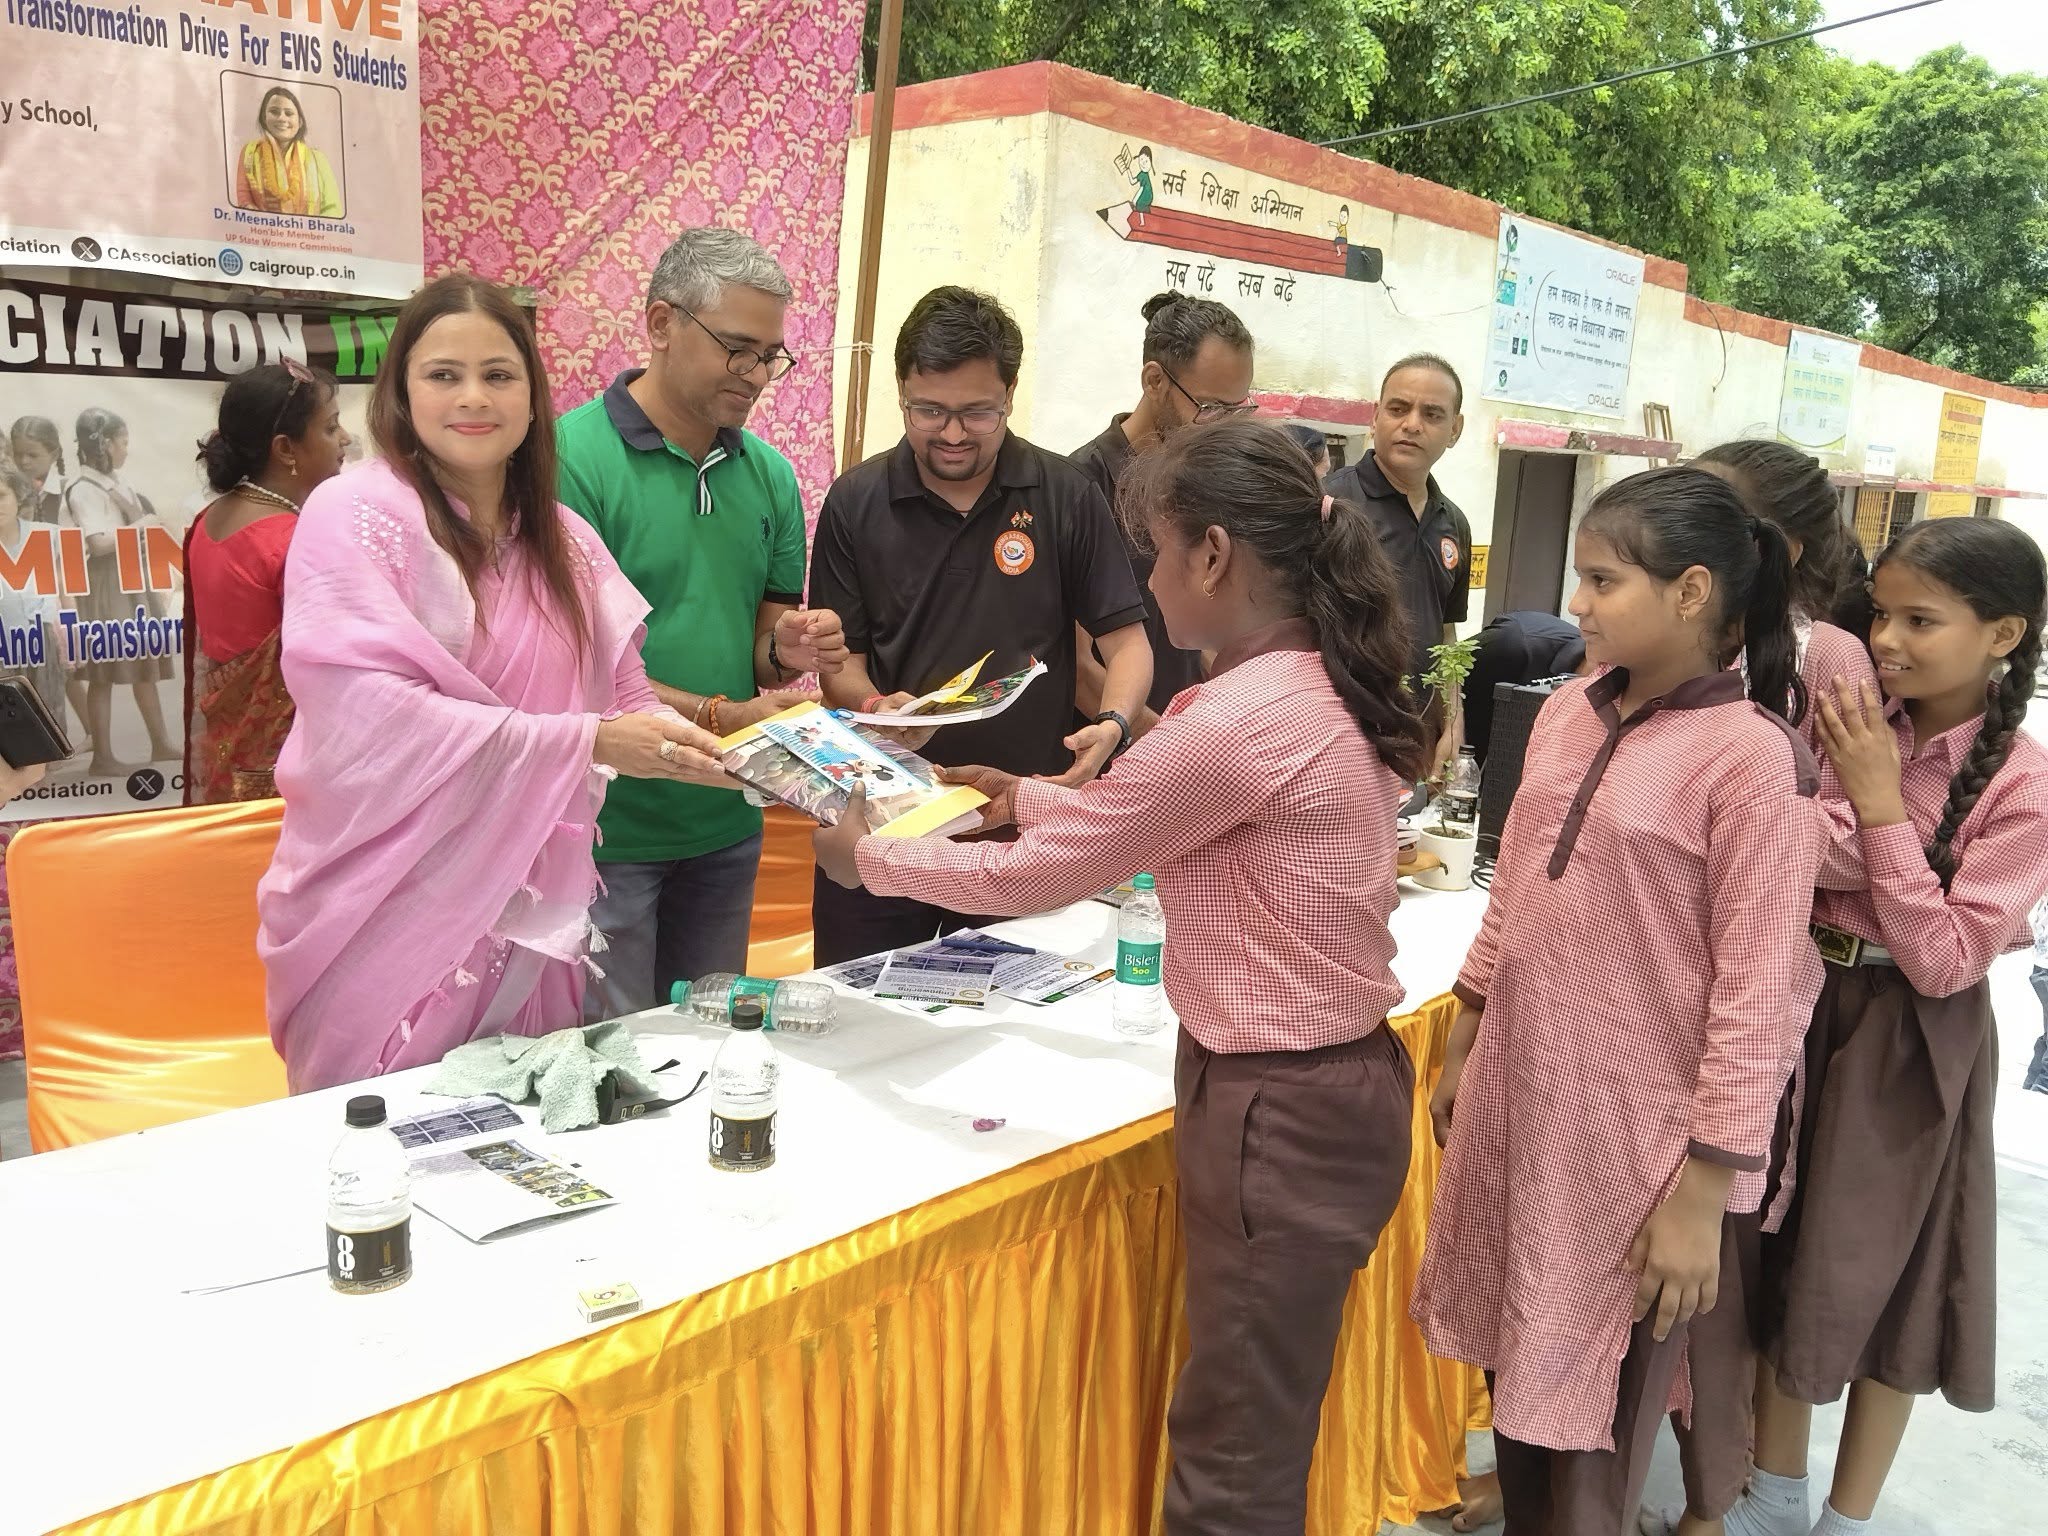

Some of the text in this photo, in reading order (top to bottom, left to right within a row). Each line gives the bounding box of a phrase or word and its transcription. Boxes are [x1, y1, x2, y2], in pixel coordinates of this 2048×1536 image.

[7, 0, 407, 91] Transformation Drive For EWS Students
[20, 98, 98, 132] School,
[1162, 169, 1304, 222] सर्व शिक्षा अभियान
[214, 207, 355, 235] Dr. Meenakshi Bharala
[250, 226, 325, 241] Hon'ble Member
[225, 233, 352, 254] UP State Women Commission
[107, 246, 216, 269] CAssociation
[249, 259, 356, 280] caigroup.co.in
[1605, 268, 1636, 286] ORACLE
[1166, 260, 1190, 288] सब
[1238, 271, 1265, 298] सब
[1587, 393, 1620, 409] ORACLE
[1124, 952, 1159, 967] Bisleri
[1132, 966, 1150, 975] 500
[711, 1116, 724, 1149] 8
[337, 1234, 356, 1272] 8
[340, 1270, 353, 1280] PM
